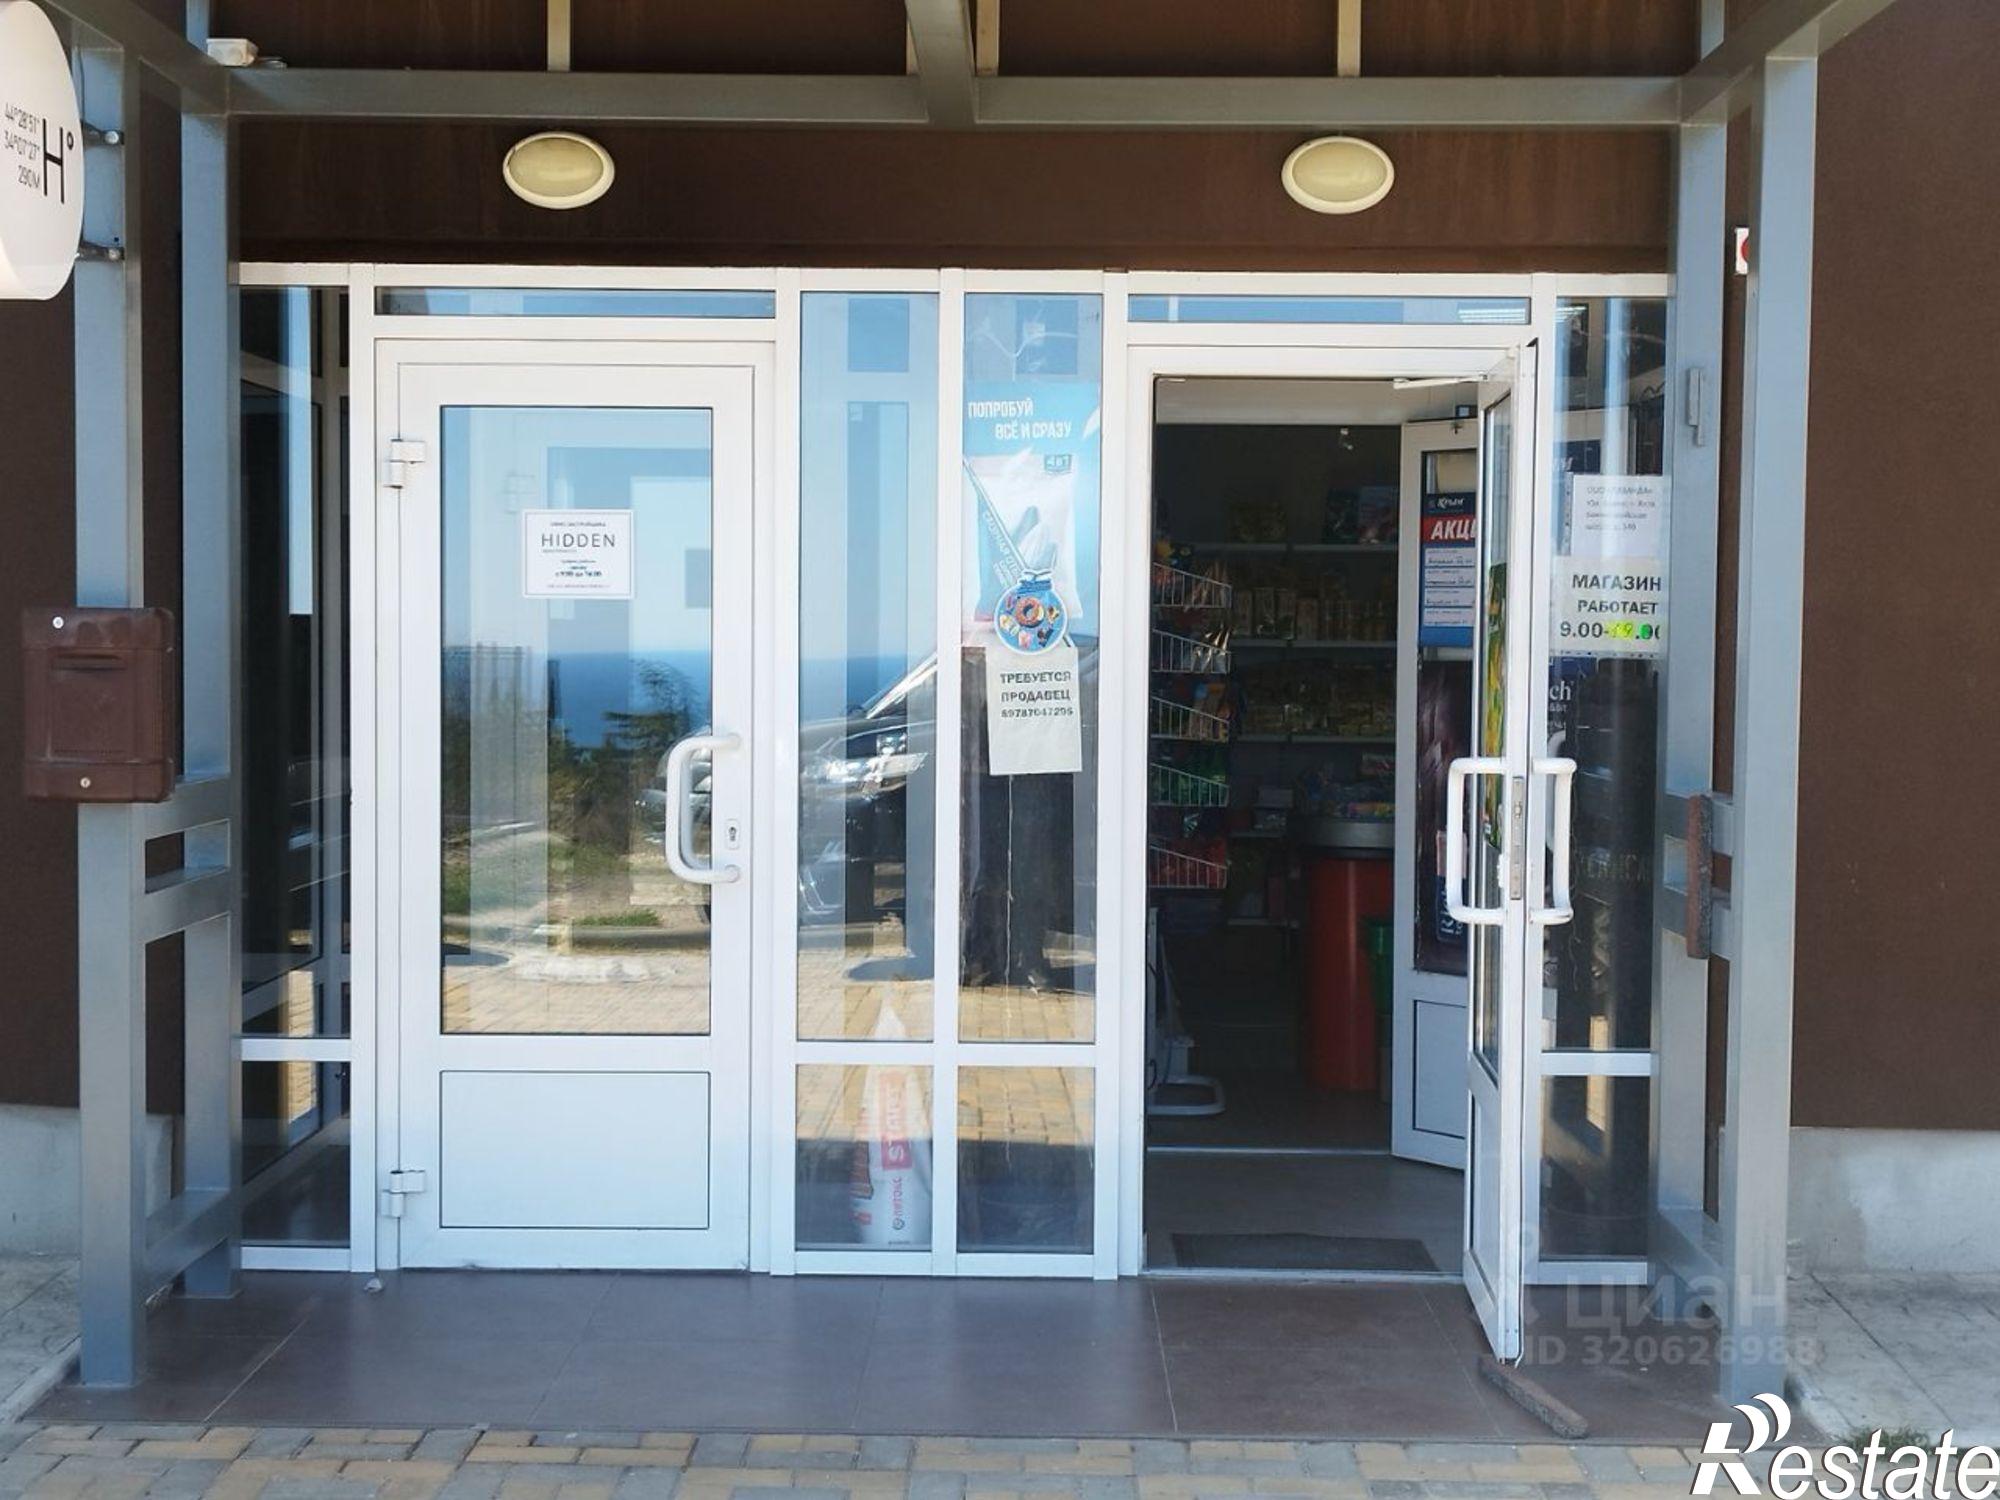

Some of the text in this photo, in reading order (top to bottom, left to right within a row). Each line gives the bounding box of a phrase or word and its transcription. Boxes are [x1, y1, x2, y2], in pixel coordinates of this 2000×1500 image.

[967, 397, 1034, 419] ПОПРОБУЙ
[995, 419, 1072, 440] ВСЁ И СРАЗУ
[541, 533, 616, 548] HIDDEN
[1572, 574, 1662, 592] МАГАЗИН
[1577, 599, 1659, 615] РАБОТАЕТ
[1000, 671, 1071, 684] ТРЕБУЕТСЯ
[1001, 689, 1071, 704] ПРОДАВЕЦ
